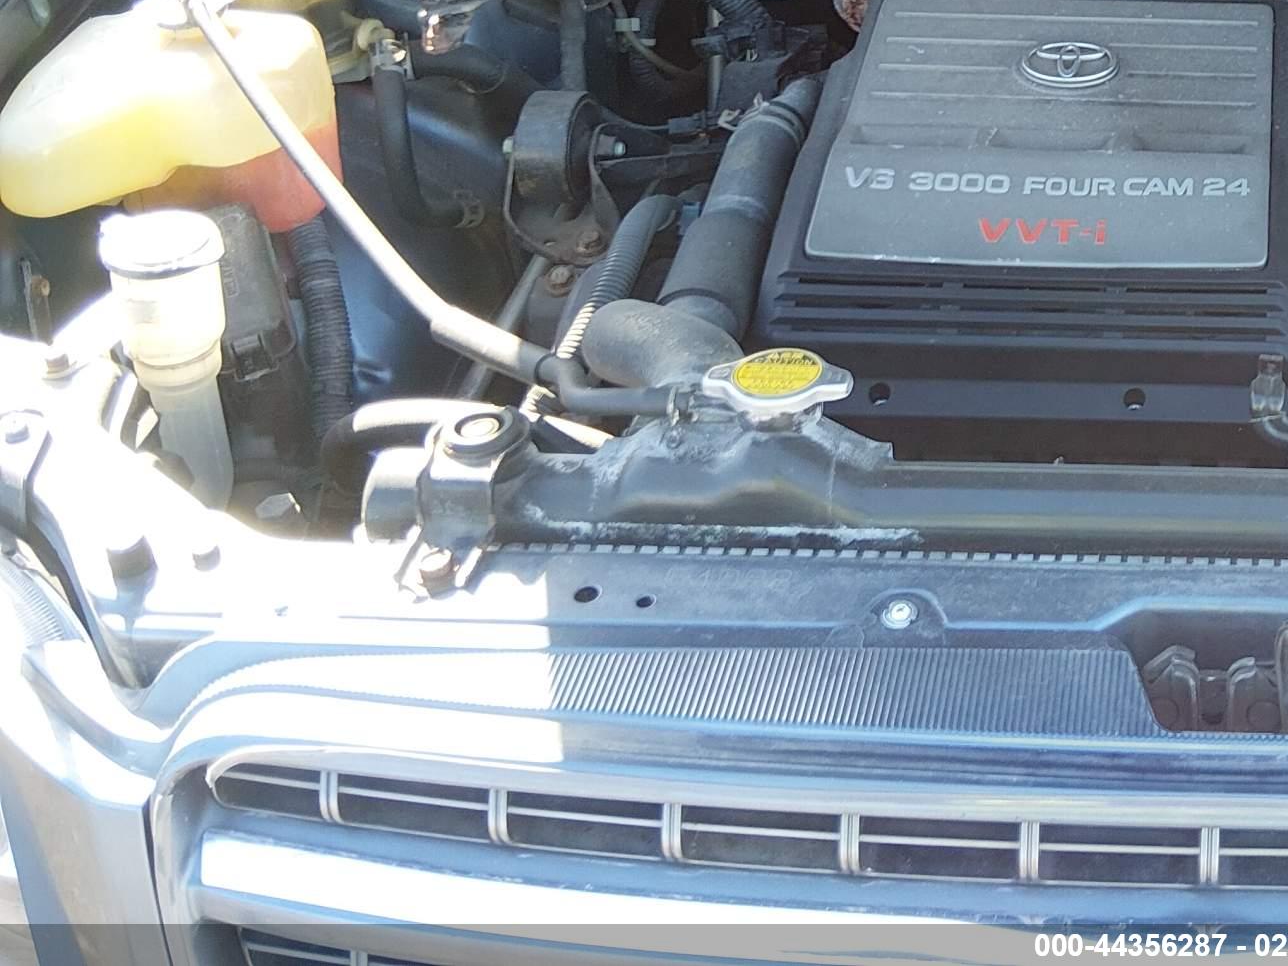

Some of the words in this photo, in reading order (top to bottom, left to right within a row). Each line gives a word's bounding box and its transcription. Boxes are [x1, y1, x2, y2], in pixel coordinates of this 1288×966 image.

[844, 166, 895, 190] V6
[908, 172, 1010, 194] 3000
[1023, 176, 1115, 196] FOUR
[1122, 177, 1194, 196] CAM
[1202, 177, 1250, 196] 24
[978, 218, 1108, 245] VVT-i
